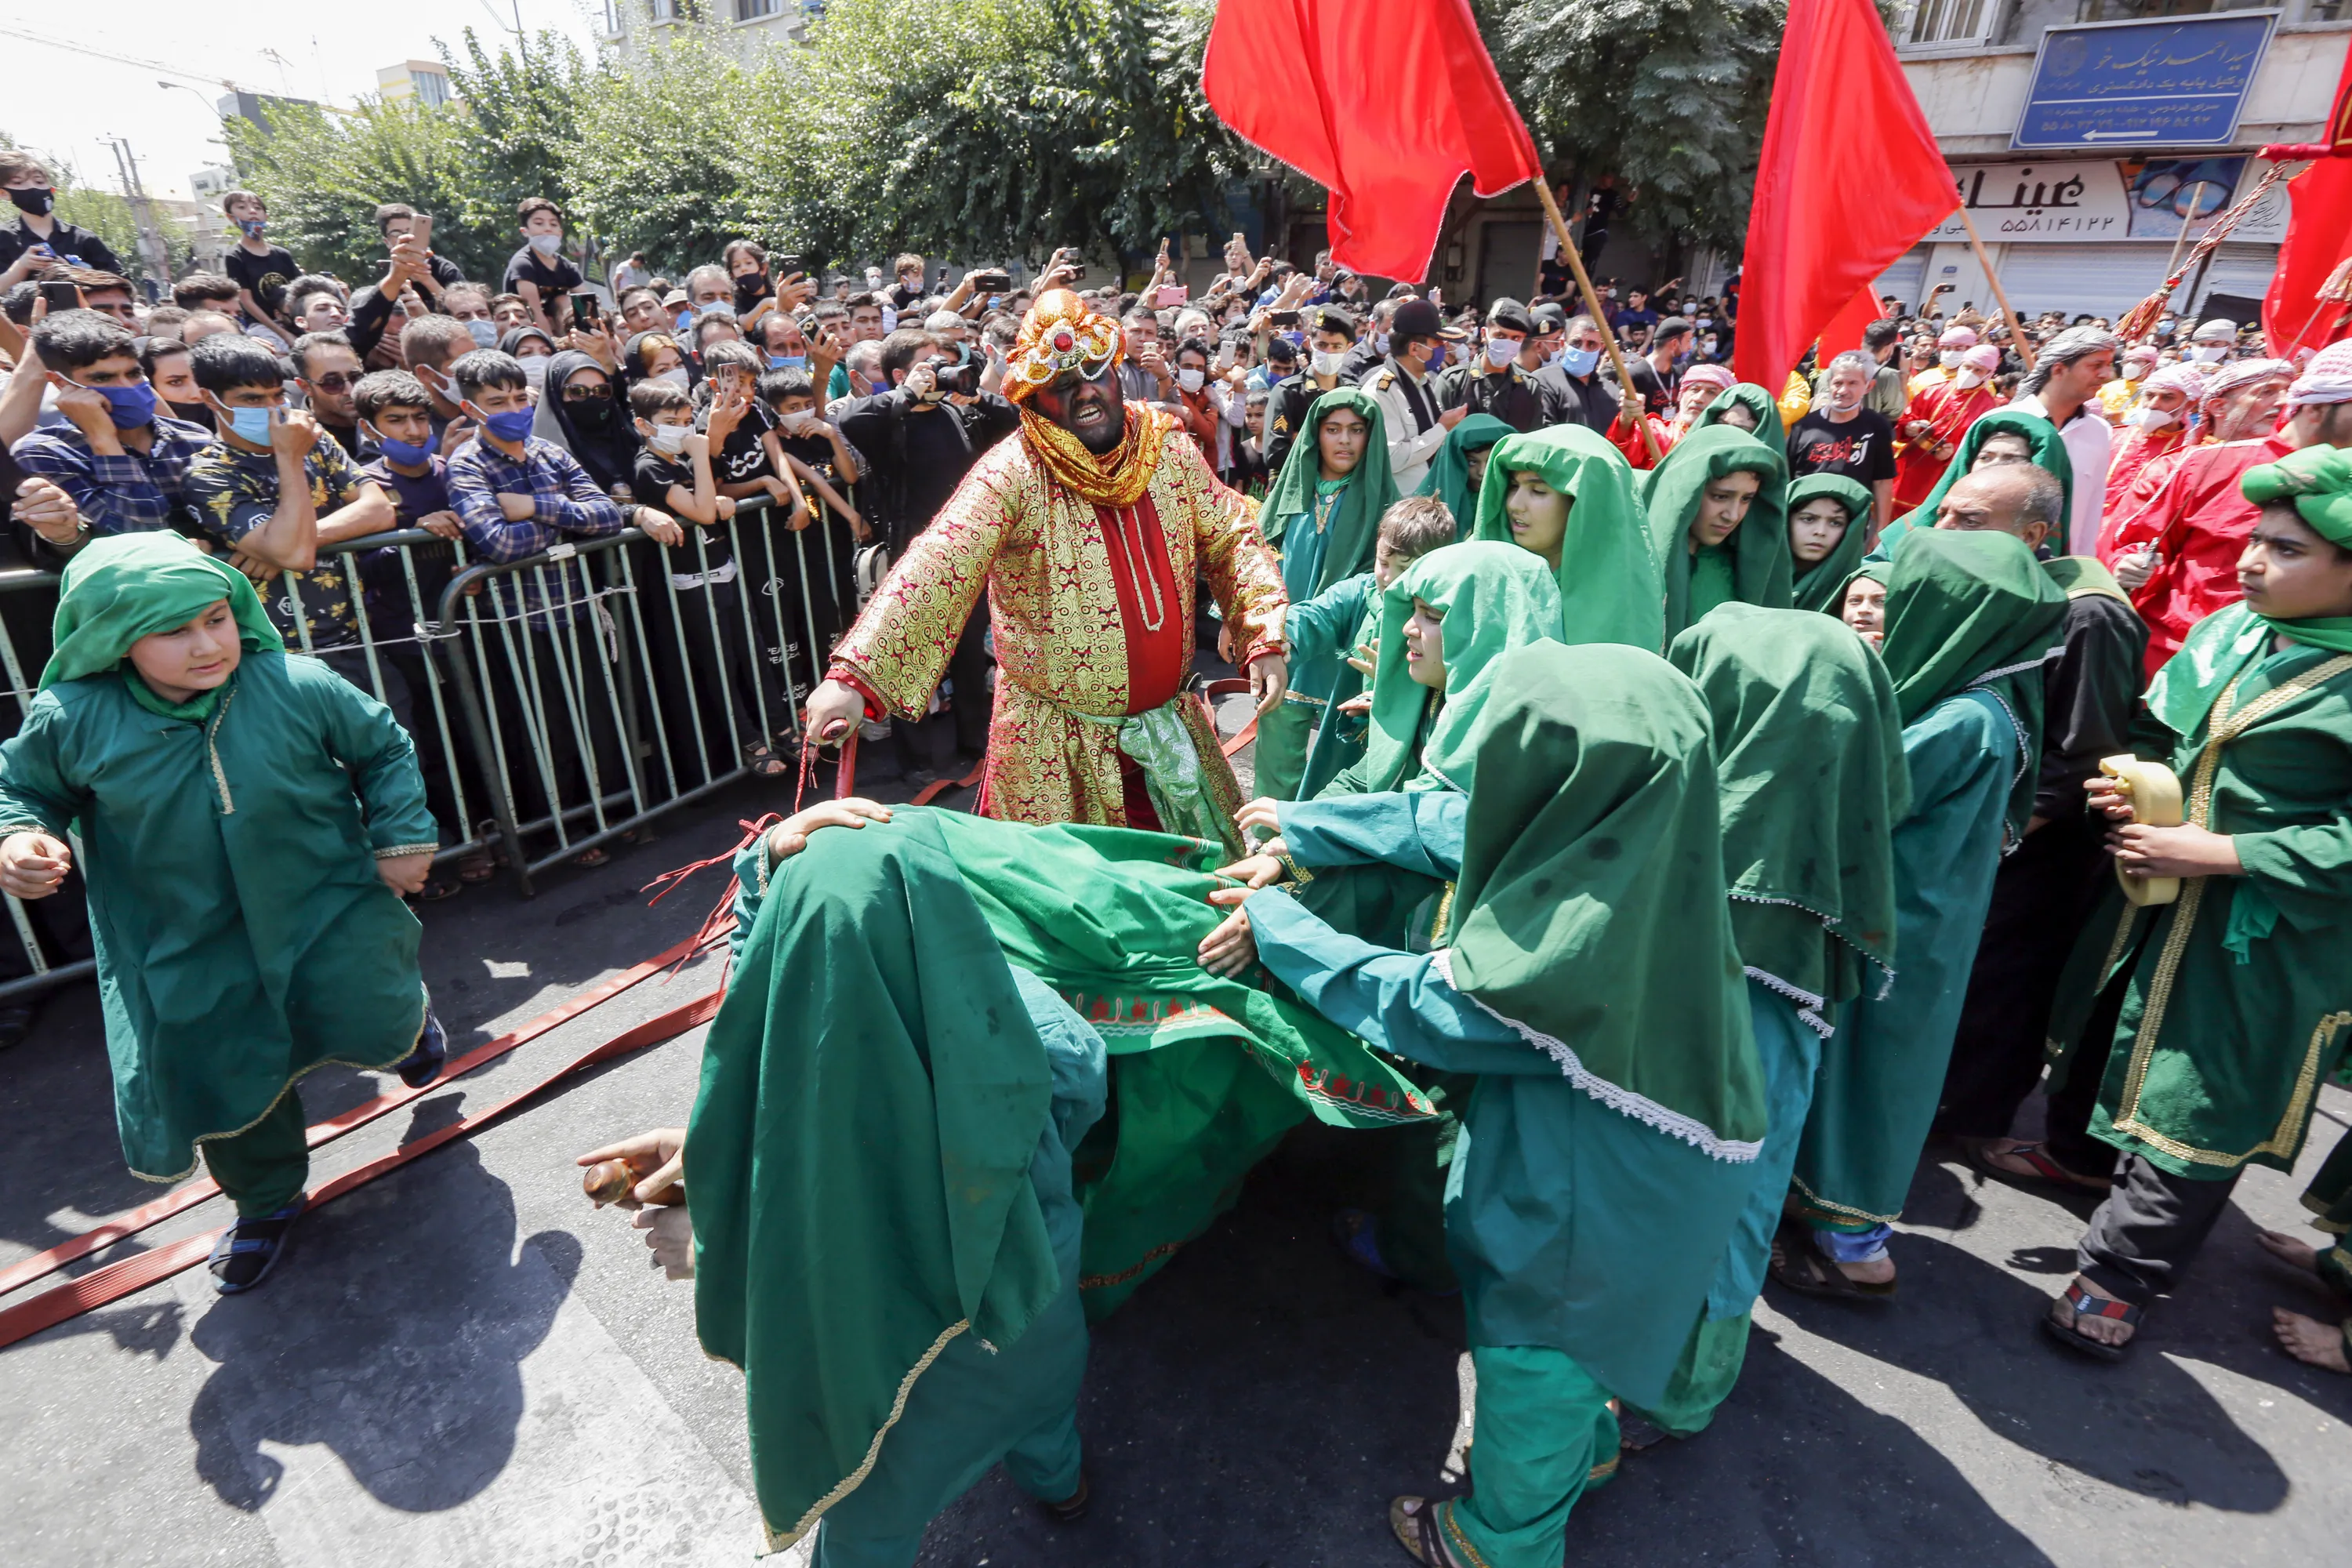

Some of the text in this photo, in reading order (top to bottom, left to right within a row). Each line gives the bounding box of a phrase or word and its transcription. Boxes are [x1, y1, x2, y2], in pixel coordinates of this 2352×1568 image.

[2092, 46, 2114, 71] خو
[2156, 41, 2230, 66] احمد
[2088, 79, 2154, 95] دادگستری
[2180, 76, 2208, 91] پایه
[2208, 75, 2245, 91] وکیل
[2001, 216, 2114, 233] ۵۵۸۱۴۱۲۲
